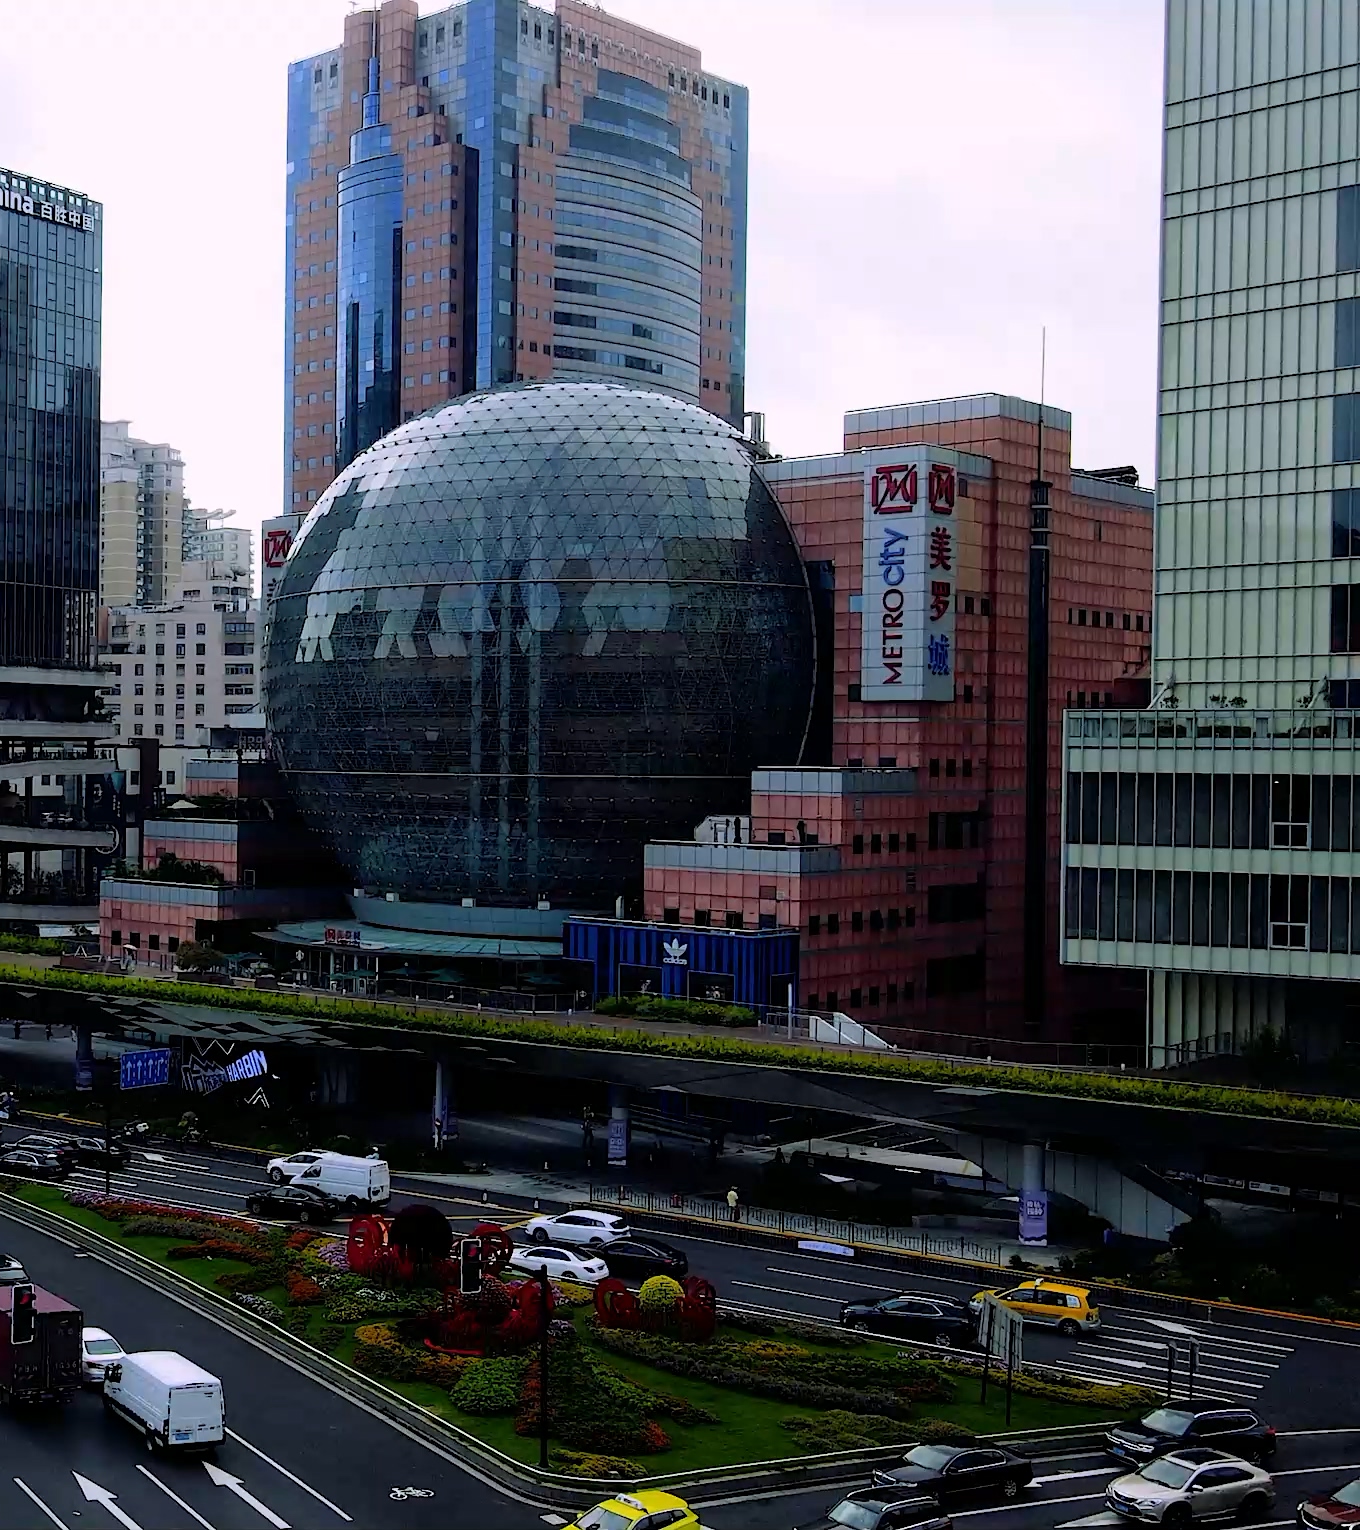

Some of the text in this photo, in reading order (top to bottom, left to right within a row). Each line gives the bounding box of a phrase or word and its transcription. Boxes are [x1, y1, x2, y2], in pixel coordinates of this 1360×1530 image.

[40, 201, 95, 232] 百胜中国
[928, 526, 952, 676] 美罗城
[226, 1049, 268, 1082] HARBIN
